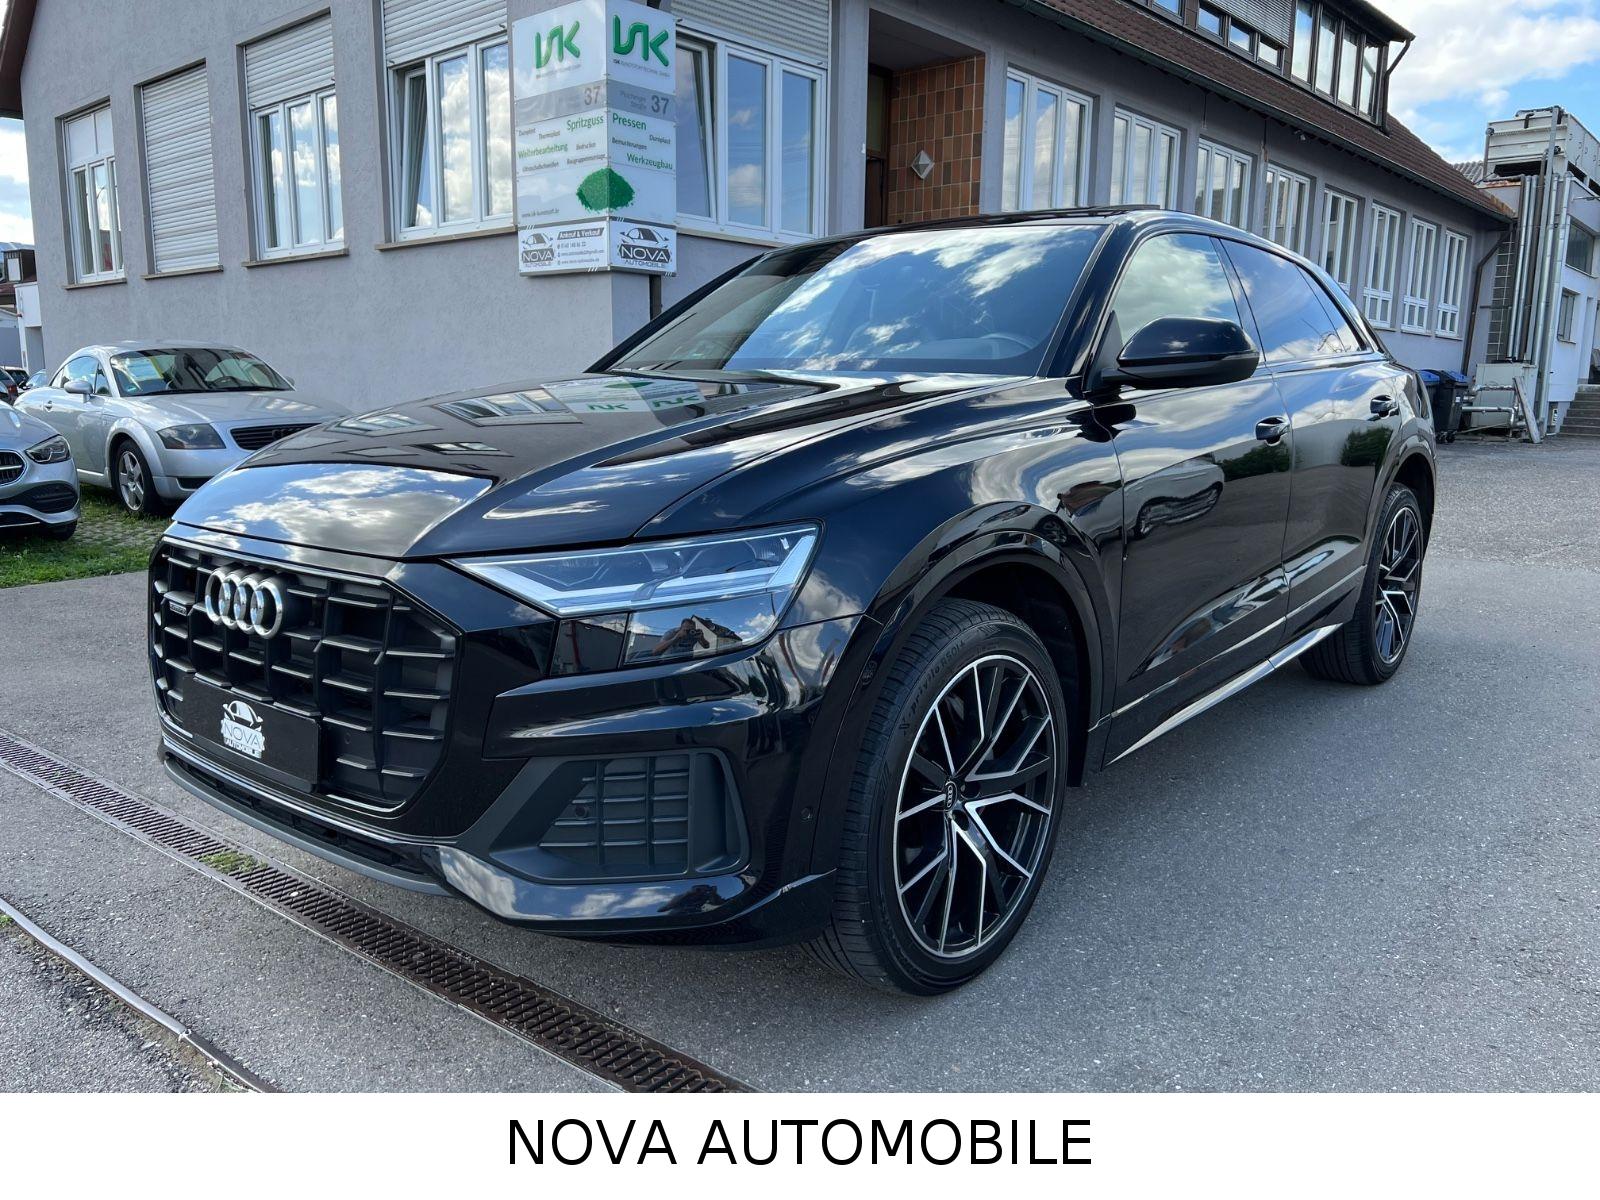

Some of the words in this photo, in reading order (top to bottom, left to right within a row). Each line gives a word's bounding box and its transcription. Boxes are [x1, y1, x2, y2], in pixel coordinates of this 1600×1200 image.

[584, 86, 601, 106] 37
[651, 95, 670, 115] 37
[566, 114, 604, 133] Spritzguss
[612, 112, 647, 131] Pressen
[626, 152, 673, 171] Werkzeugbau
[581, 229, 601, 237] Verkauf
[522, 251, 554, 263] NOVA
[621, 247, 668, 261] NOVA
[224, 721, 261, 751] NOVA
